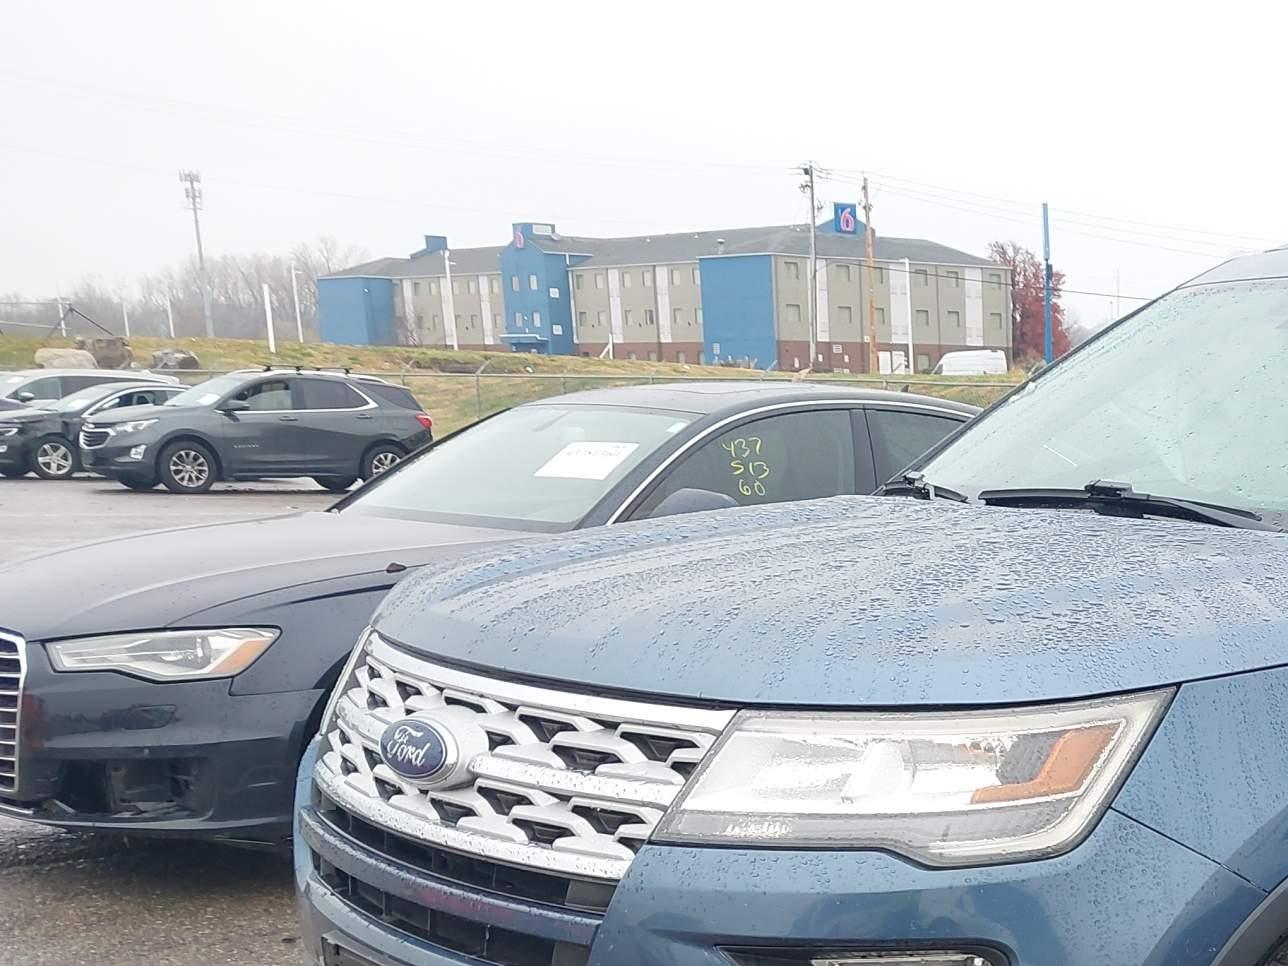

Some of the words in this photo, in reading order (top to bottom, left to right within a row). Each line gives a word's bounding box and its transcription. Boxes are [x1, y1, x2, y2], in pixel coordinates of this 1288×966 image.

[841, 207, 854, 232] 6
[722, 436, 761, 458] 437
[730, 460, 769, 479] 513
[739, 479, 766, 496] 60
[387, 725, 431, 767] Ford
